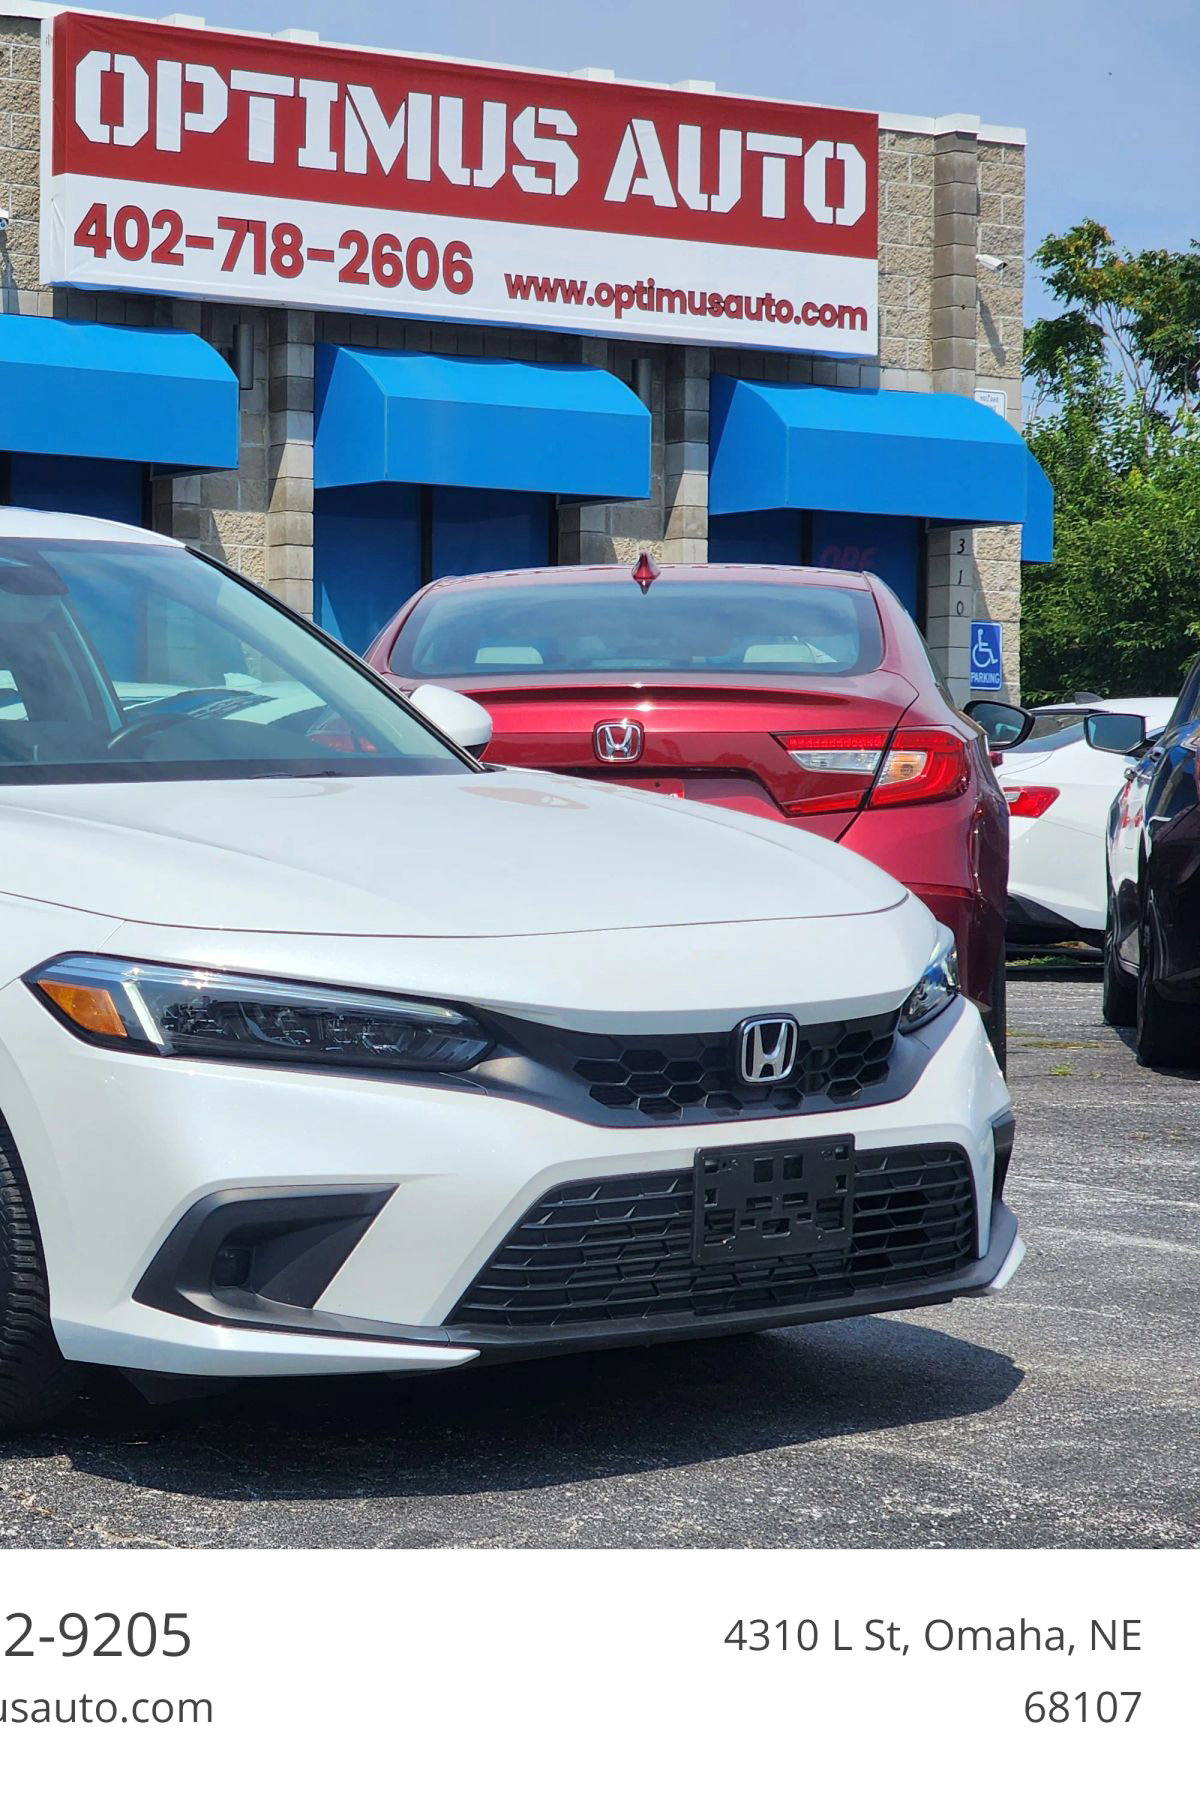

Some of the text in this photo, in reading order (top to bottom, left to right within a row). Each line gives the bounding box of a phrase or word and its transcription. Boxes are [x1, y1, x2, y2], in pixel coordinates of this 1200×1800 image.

[75, 50, 867, 227] OPTIMUS AUTO
[75, 203, 474, 294] 402-718-2606
[505, 273, 868, 332] www.optimusauto.com
[970, 672, 1000, 685] PARKING
